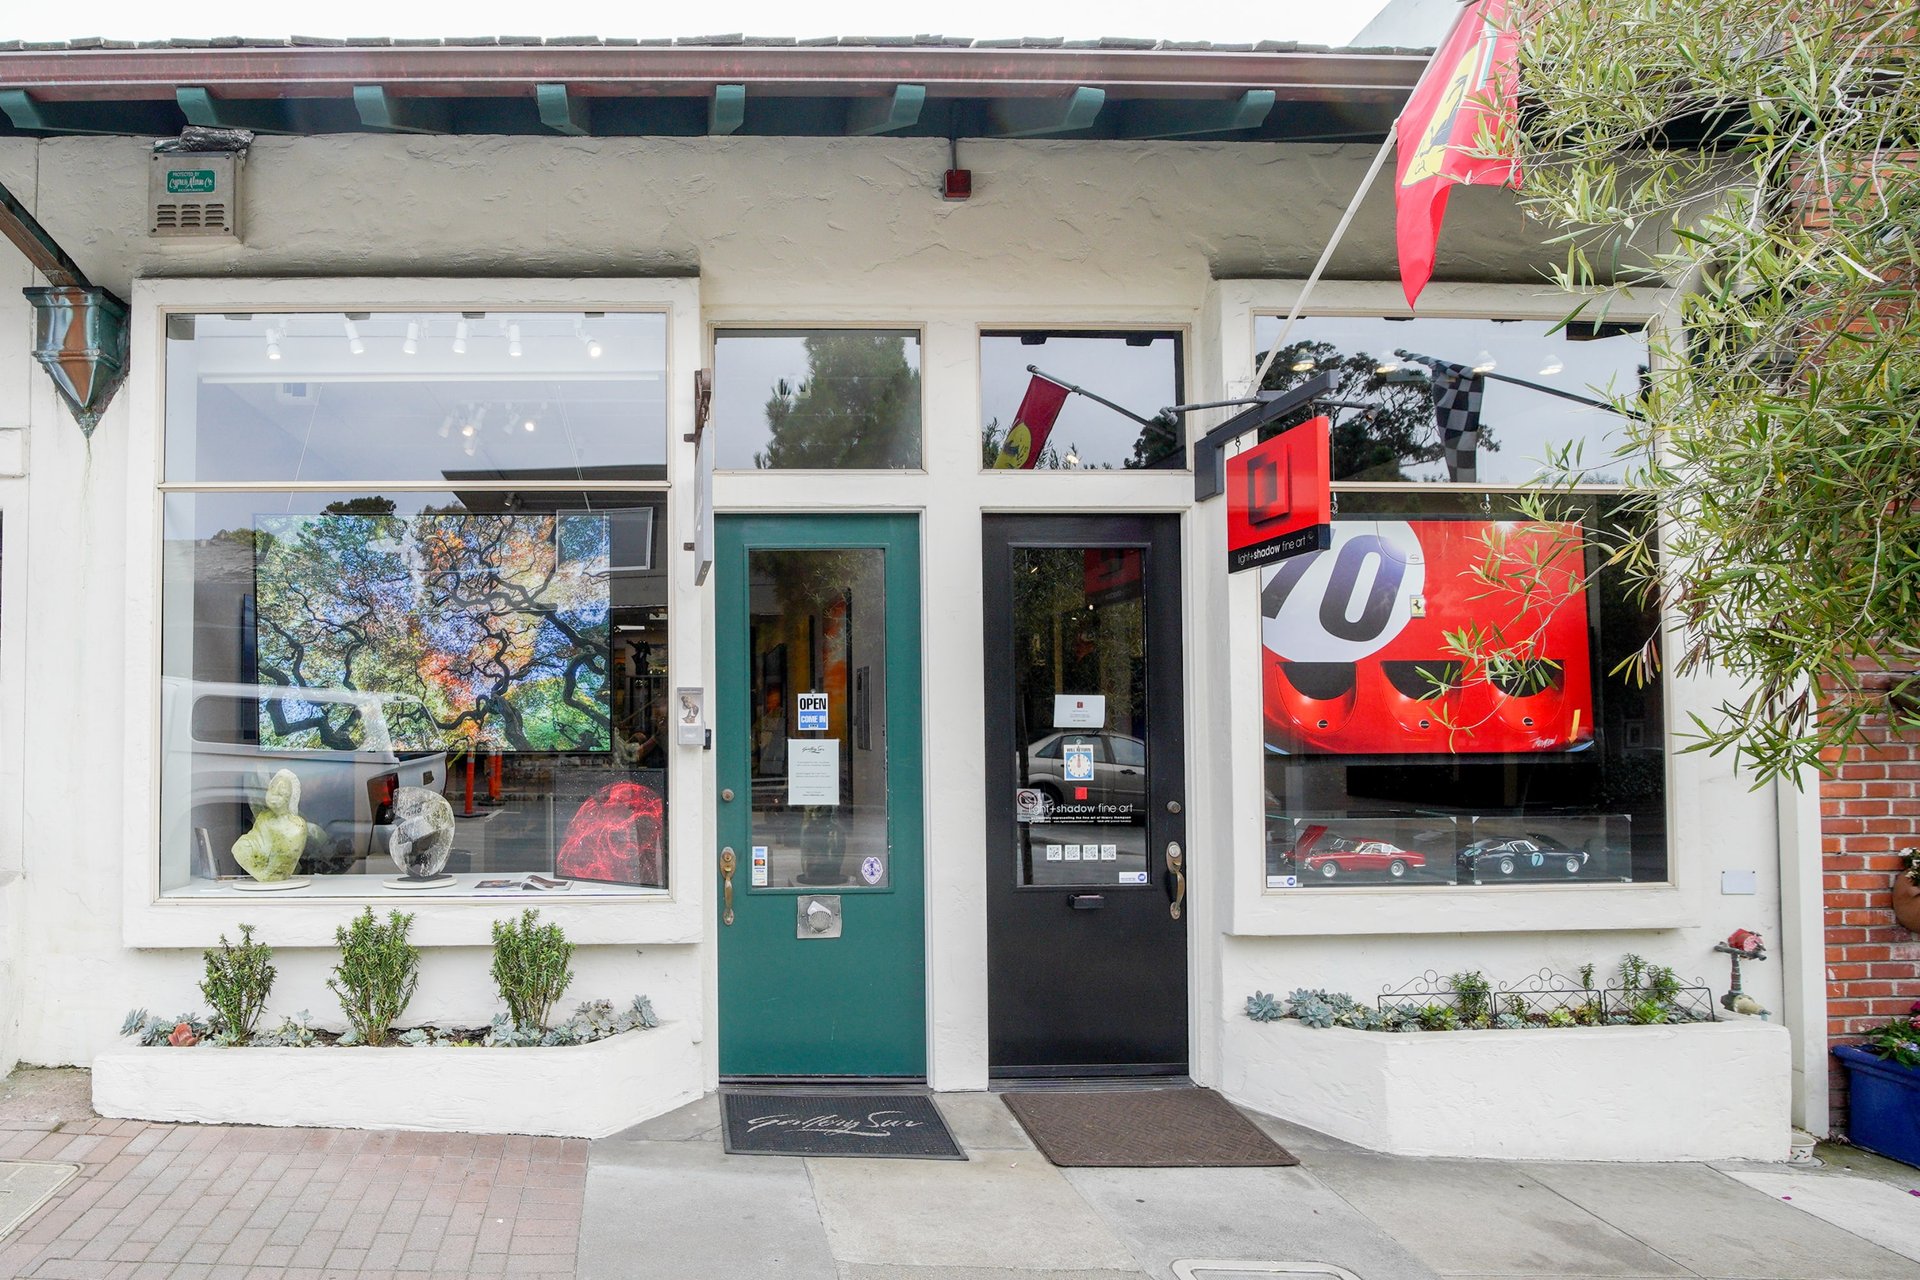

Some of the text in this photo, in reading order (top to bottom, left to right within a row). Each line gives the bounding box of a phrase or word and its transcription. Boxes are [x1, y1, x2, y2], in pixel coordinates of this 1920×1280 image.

[1237, 535, 1306, 566] light+shadow fine art
[800, 697, 827, 710] OPEN
[800, 715, 827, 724] COME IN
[1097, 803, 1117, 813] fine
[1118, 803, 1134, 813] art
